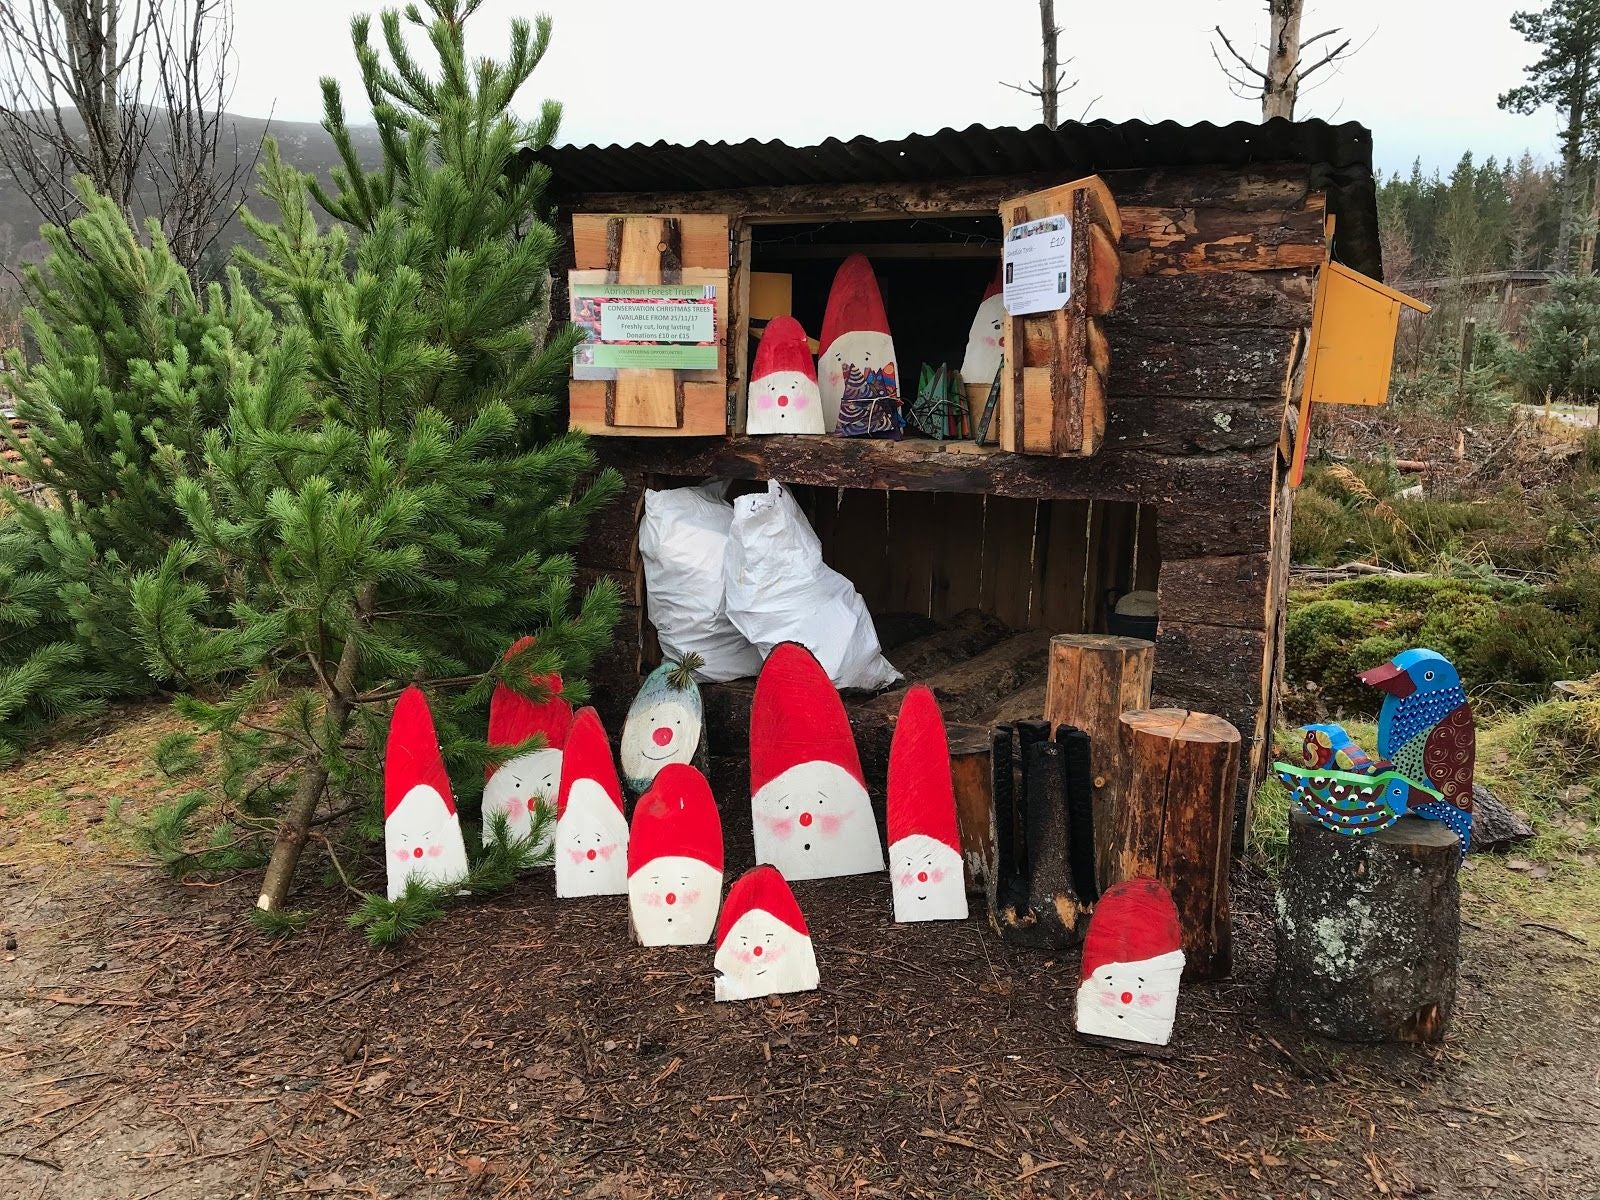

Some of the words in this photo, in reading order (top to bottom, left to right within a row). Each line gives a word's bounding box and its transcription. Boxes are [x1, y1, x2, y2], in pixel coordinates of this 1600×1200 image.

[1050, 237, 1065, 248] £10
[604, 287, 645, 296] Abriachan
[647, 287, 673, 296] Forest
[674, 287, 694, 296] Trust
[621, 323, 643, 331] Freshly
[656, 323, 670, 331] long
[670, 324, 691, 332] lasting
